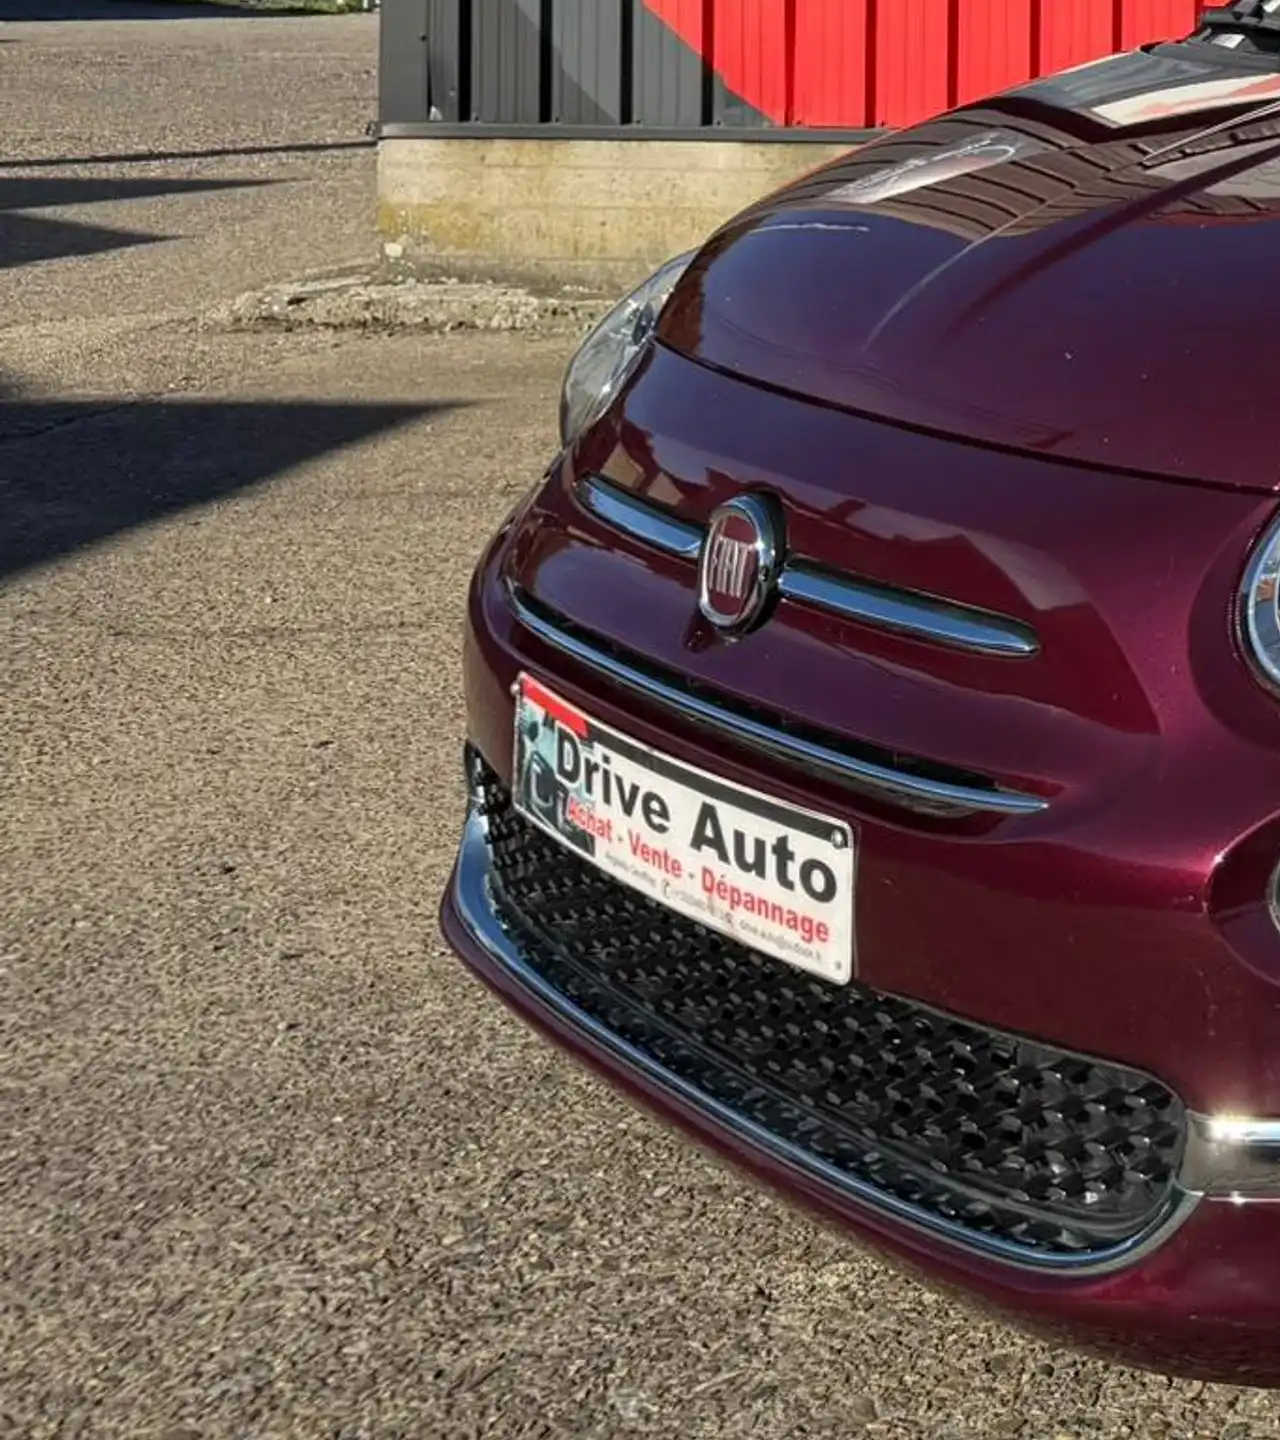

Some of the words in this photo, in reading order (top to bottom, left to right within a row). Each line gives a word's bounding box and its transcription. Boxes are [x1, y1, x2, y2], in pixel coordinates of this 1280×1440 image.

[709, 533, 758, 599] FIAT
[556, 724, 672, 835] Drive
[688, 800, 838, 904] Auto
[627, 829, 683, 879] Vente
[701, 864, 830, 945] Dépannage
